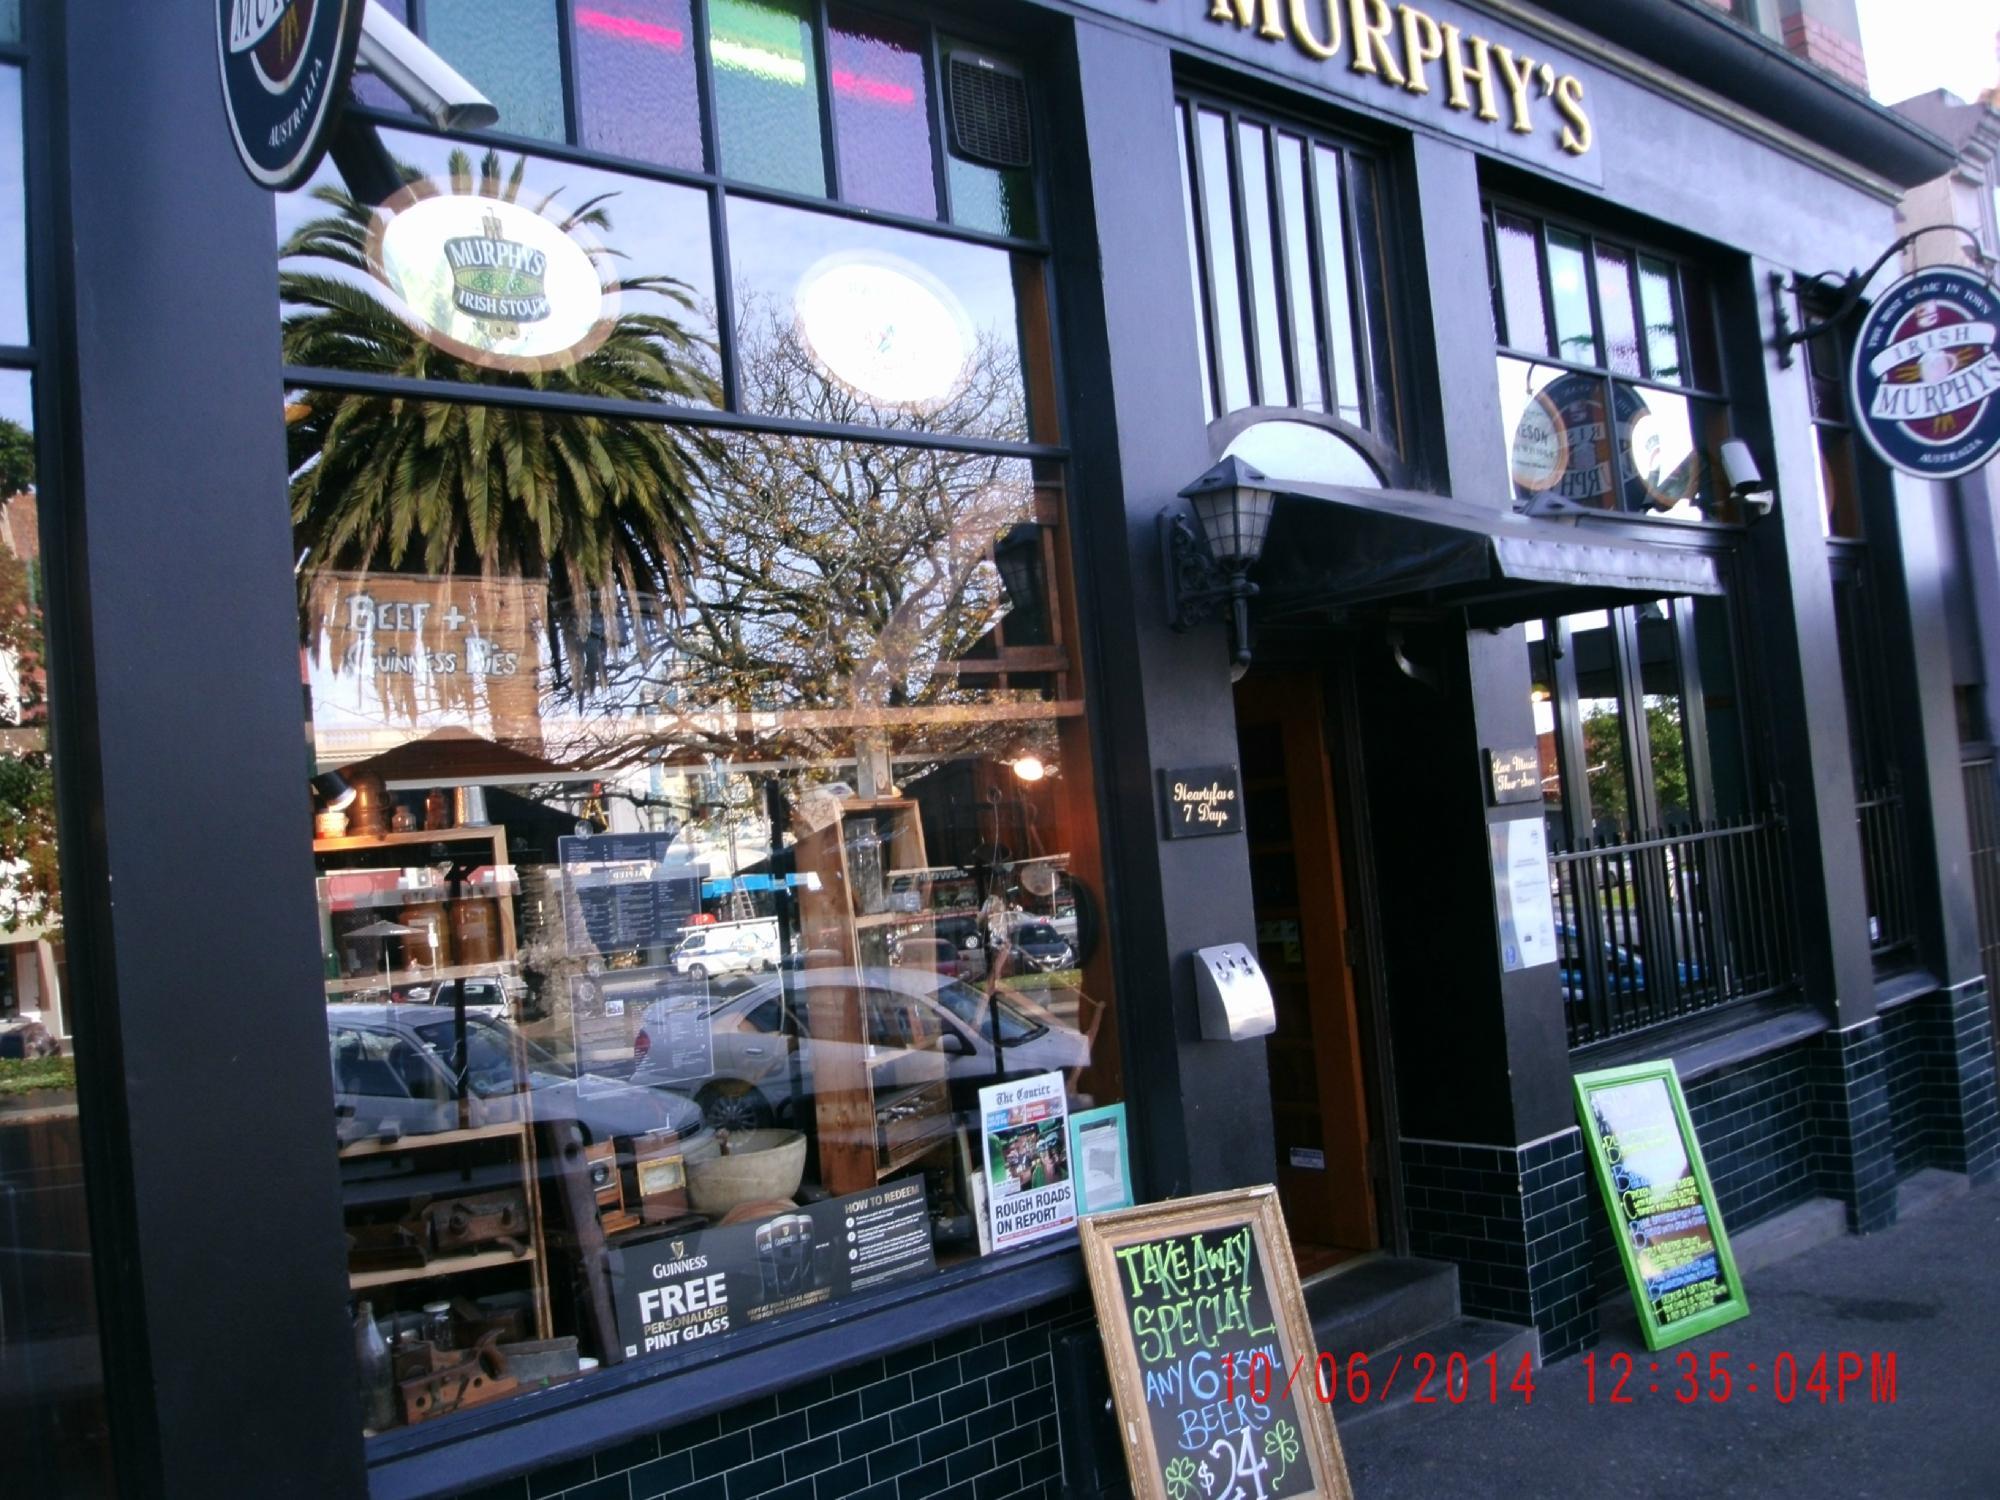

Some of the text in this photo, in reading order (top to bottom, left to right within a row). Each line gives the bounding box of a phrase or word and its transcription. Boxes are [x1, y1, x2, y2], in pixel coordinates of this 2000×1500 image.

[269, 58, 322, 148] AUSTRALIA
[459, 290, 548, 317] IRISH STOUT
[1895, 325, 1971, 361] IRISH
[345, 593, 431, 632] BEEF
[1183, 802, 1228, 827] 7 Days
[996, 1084, 1051, 1105] The Courier
[844, 1198, 869, 1215] HOW
[869, 1195, 882, 1208] TO
[884, 1184, 920, 1204] REDEEM
[995, 1196, 1034, 1219] ROUGH
[1036, 1186, 1072, 1207] ROADS
[996, 1219, 1013, 1236] ON
[1015, 1205, 1058, 1230] REPORT
[652, 1255, 708, 1280] GUINNESS
[638, 1272, 728, 1324] FREE
[644, 1305, 728, 1334] PERSONALISED
[644, 1316, 730, 1352] PINT GLASS
[1133, 1286, 1277, 1362] SPECIAL
[1147, 1360, 1184, 1407] ANY
[1188, 1351, 1220, 1399] 6
[1177, 1390, 1271, 1450] BEERS
